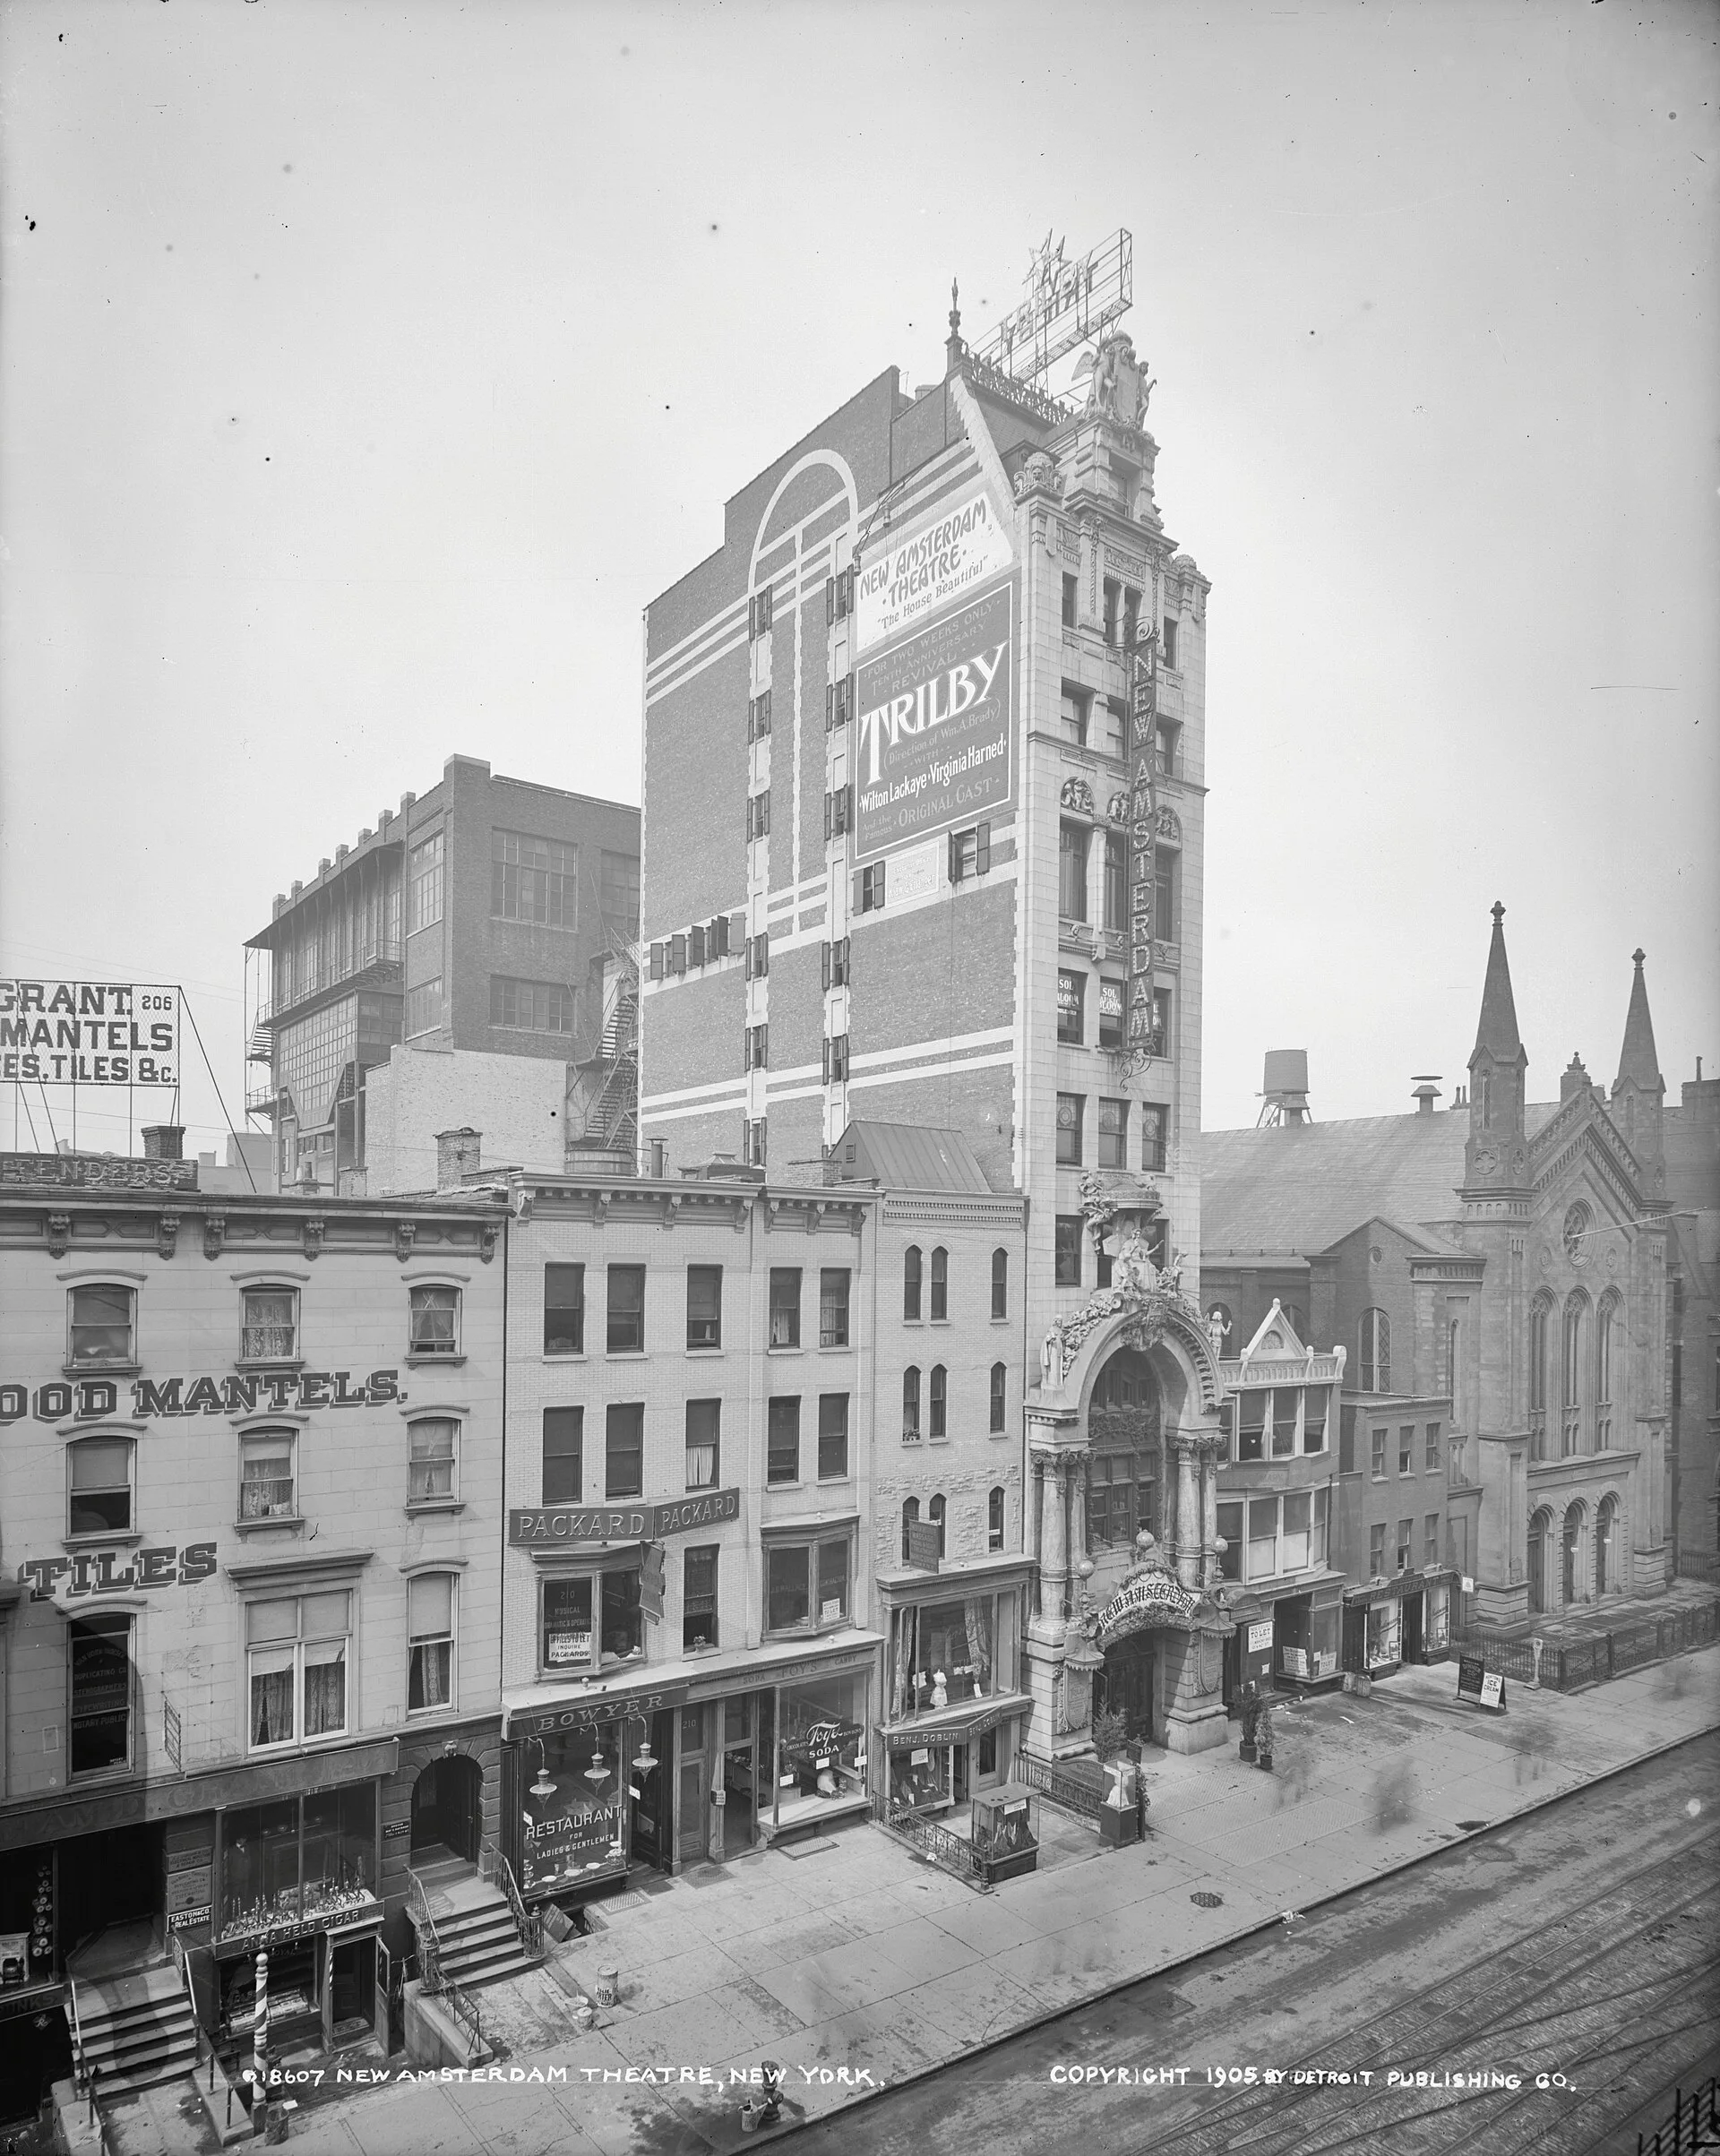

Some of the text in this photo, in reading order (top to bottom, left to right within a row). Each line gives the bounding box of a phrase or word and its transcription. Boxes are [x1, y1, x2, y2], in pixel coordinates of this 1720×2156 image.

[859, 499, 986, 600] NEW AMSTERDAM
[889, 543, 961, 607] THEATRE
[903, 591, 932, 616] House
[891, 646, 915, 663] TWO
[920, 620, 959, 649] WEEKS
[964, 602, 993, 625] ONLY
[871, 621, 986, 696] TENTH ANNIVERSARY
[891, 650, 958, 693] REVIVAL
[859, 638, 1011, 788] TRILBY
[929, 728, 939, 746] of
[914, 749, 939, 765] WITH
[860, 733, 1004, 814] Wilton Lackaye Virginia Harned
[899, 777, 993, 828] ORIGINAL CAST
[879, 814, 891, 826] the
[864, 826, 893, 842] Famous
[1130, 649, 1153, 1037] NEW AMSTERDAM
[1059, 979, 1074, 991] SOL
[1102, 987, 1117, 998] SOL
[142, 995, 172, 1010] 206
[0, 1018, 173, 1052] MANTELS
[50, 1054, 129, 1081] TILES
[518, 1496, 736, 1538] PACKARD PACKARD
[17, 1542, 217, 1603] TILES
[1370, 1576, 1440, 1601] RESTAURANT
[555, 1606, 580, 1616] MUSICAL
[1259, 1628, 1271, 1636] LET
[834, 1654, 857, 1665] CANDY
[1484, 1685, 1500, 1693] CREAM
[1487, 1679, 1498, 1687] ICE
[538, 1696, 663, 1732] BOWYER
[682, 1719, 696, 1729] 210
[809, 1744, 839, 1758] SODA
[893, 1732, 959, 1745] BENJ. DOBLIN
[526, 1804, 623, 1841] RESTAURANT
[537, 1833, 615, 1860] LADIES & GENTLEMEN
[569, 1832, 583, 1841] FOR
[175, 1914, 211, 1928] REAL ESTATE
[283, 1922, 315, 1939] HELD
[322, 1910, 360, 1929] CIGAR
